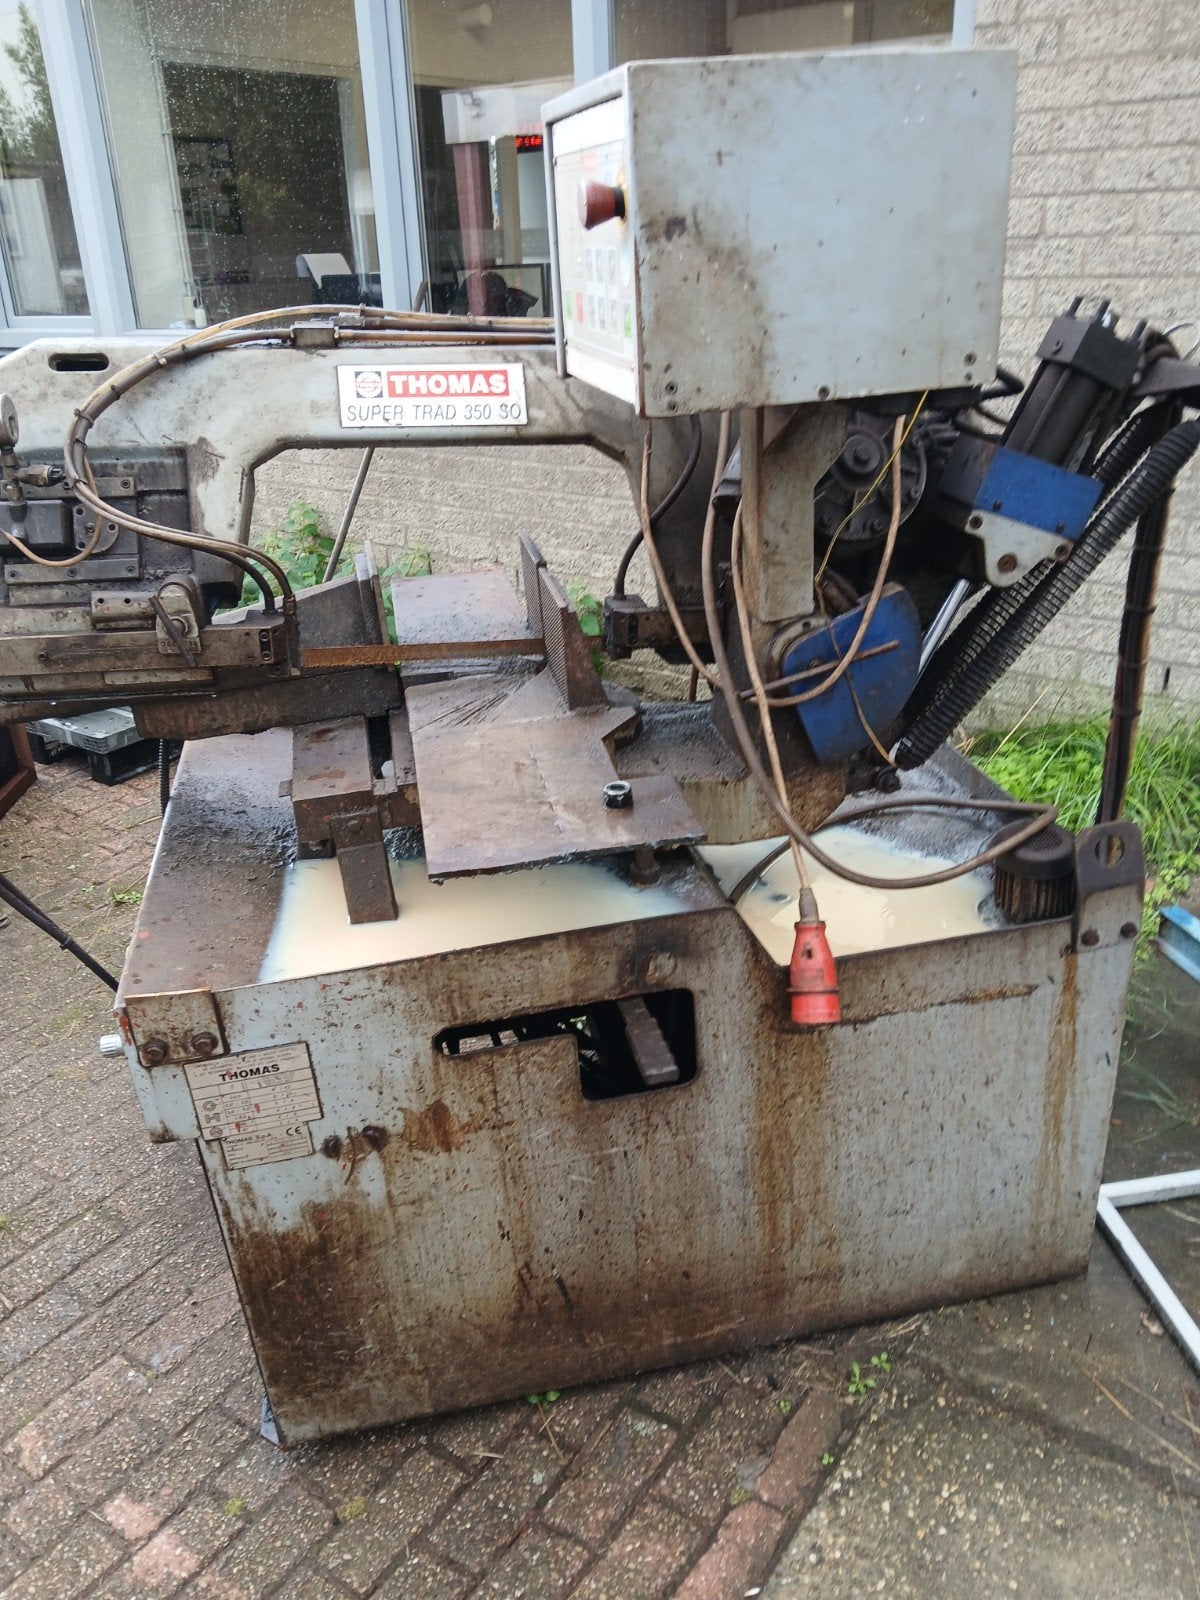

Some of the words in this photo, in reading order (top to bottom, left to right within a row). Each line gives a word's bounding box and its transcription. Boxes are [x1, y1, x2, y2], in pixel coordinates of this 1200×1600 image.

[390, 374, 507, 395] THOMAS
[347, 405, 404, 422] SUPER
[412, 404, 457, 421] TRAD
[464, 404, 492, 420] 350
[219, 1064, 280, 1082] THOMAS
